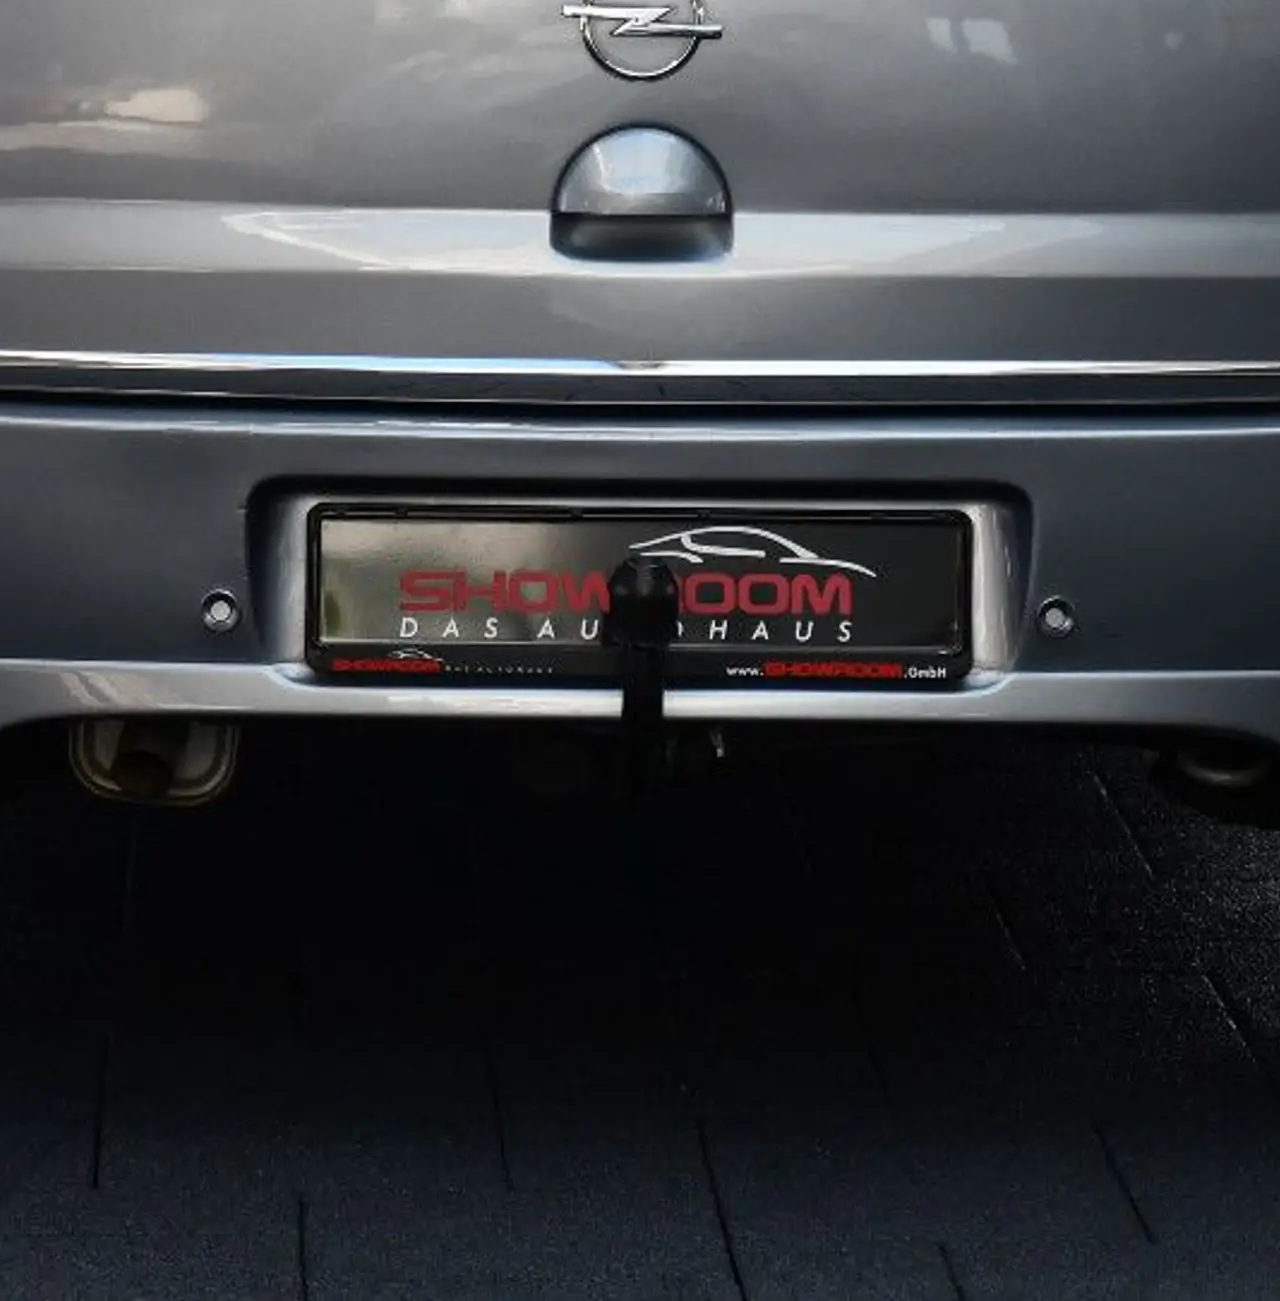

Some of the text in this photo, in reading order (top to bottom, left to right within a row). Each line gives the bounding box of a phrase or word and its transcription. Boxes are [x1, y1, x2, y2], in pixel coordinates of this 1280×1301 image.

[400, 569, 853, 616] SHOWOOM
[400, 617, 853, 643] DAS AUHAUS
